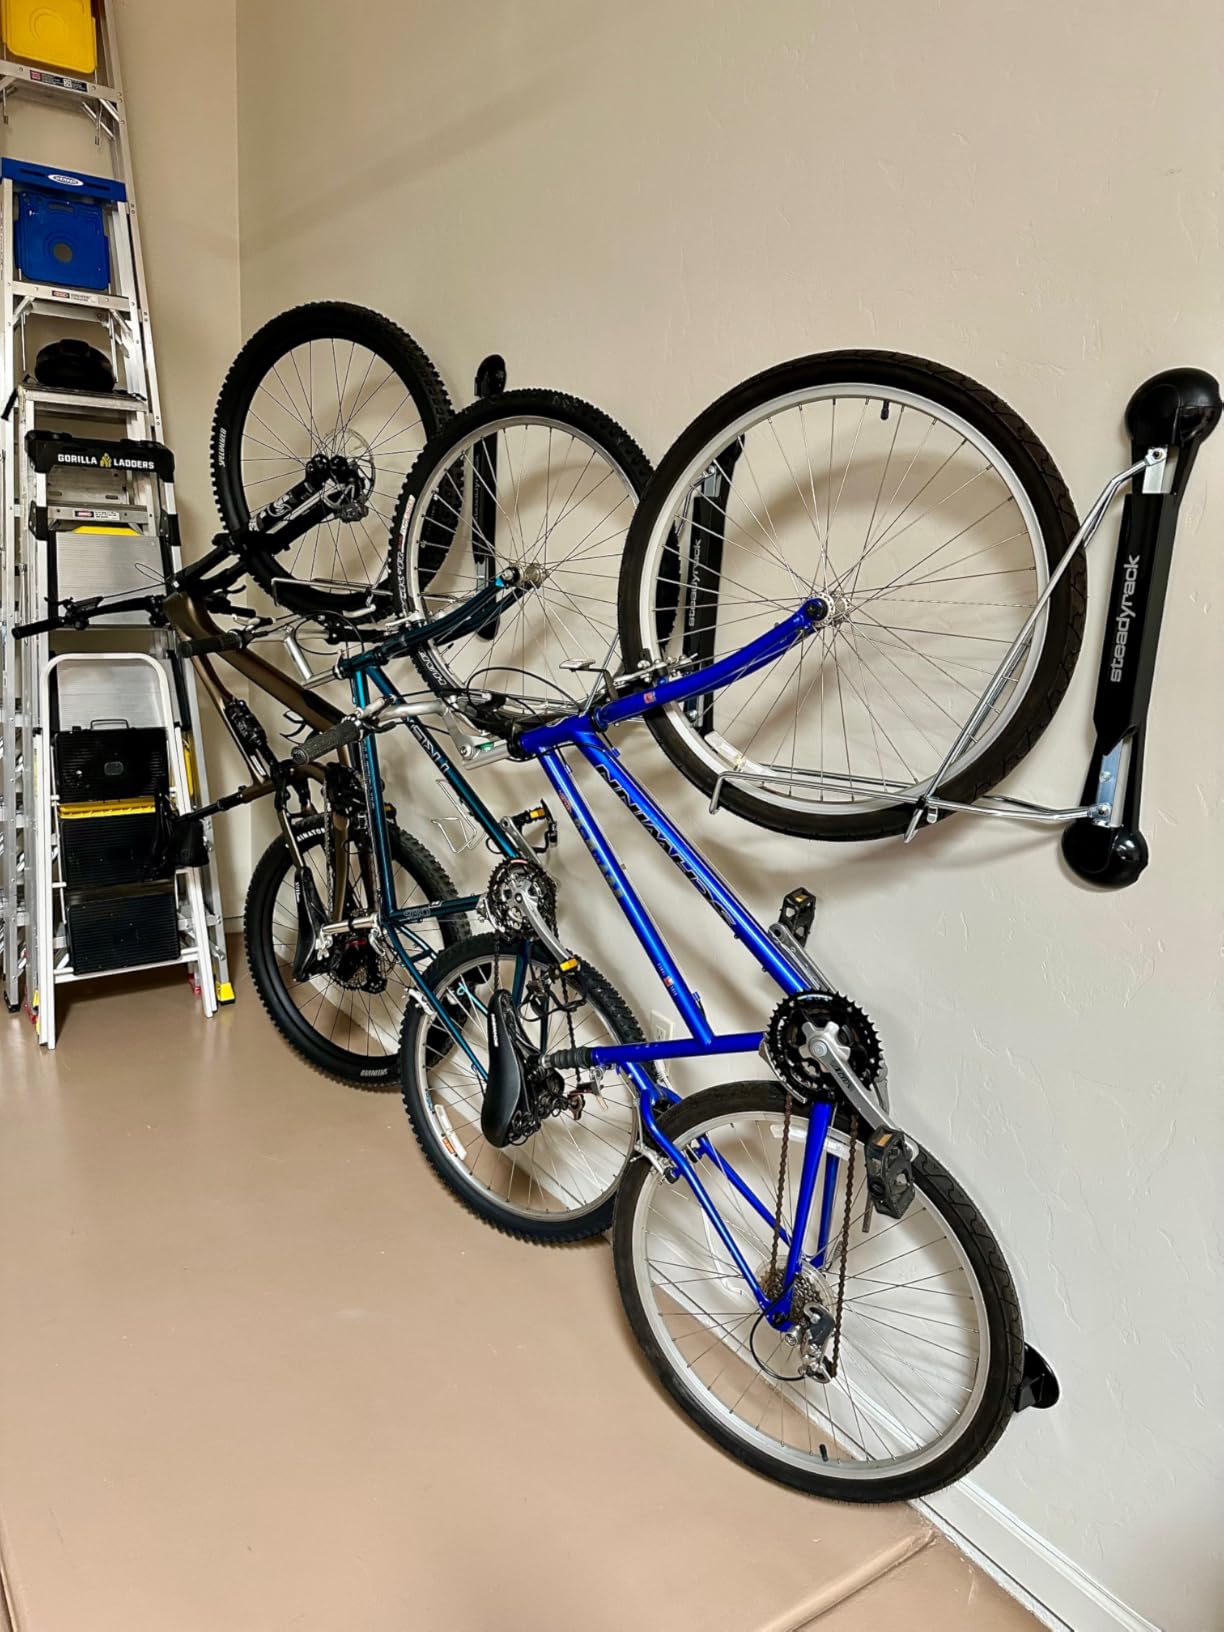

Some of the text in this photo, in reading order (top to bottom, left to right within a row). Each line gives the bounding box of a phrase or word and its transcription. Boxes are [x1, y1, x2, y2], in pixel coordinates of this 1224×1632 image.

[57, 453, 155, 470] GORILLA LADDERS
[1110, 554, 1140, 682] steadyrack
